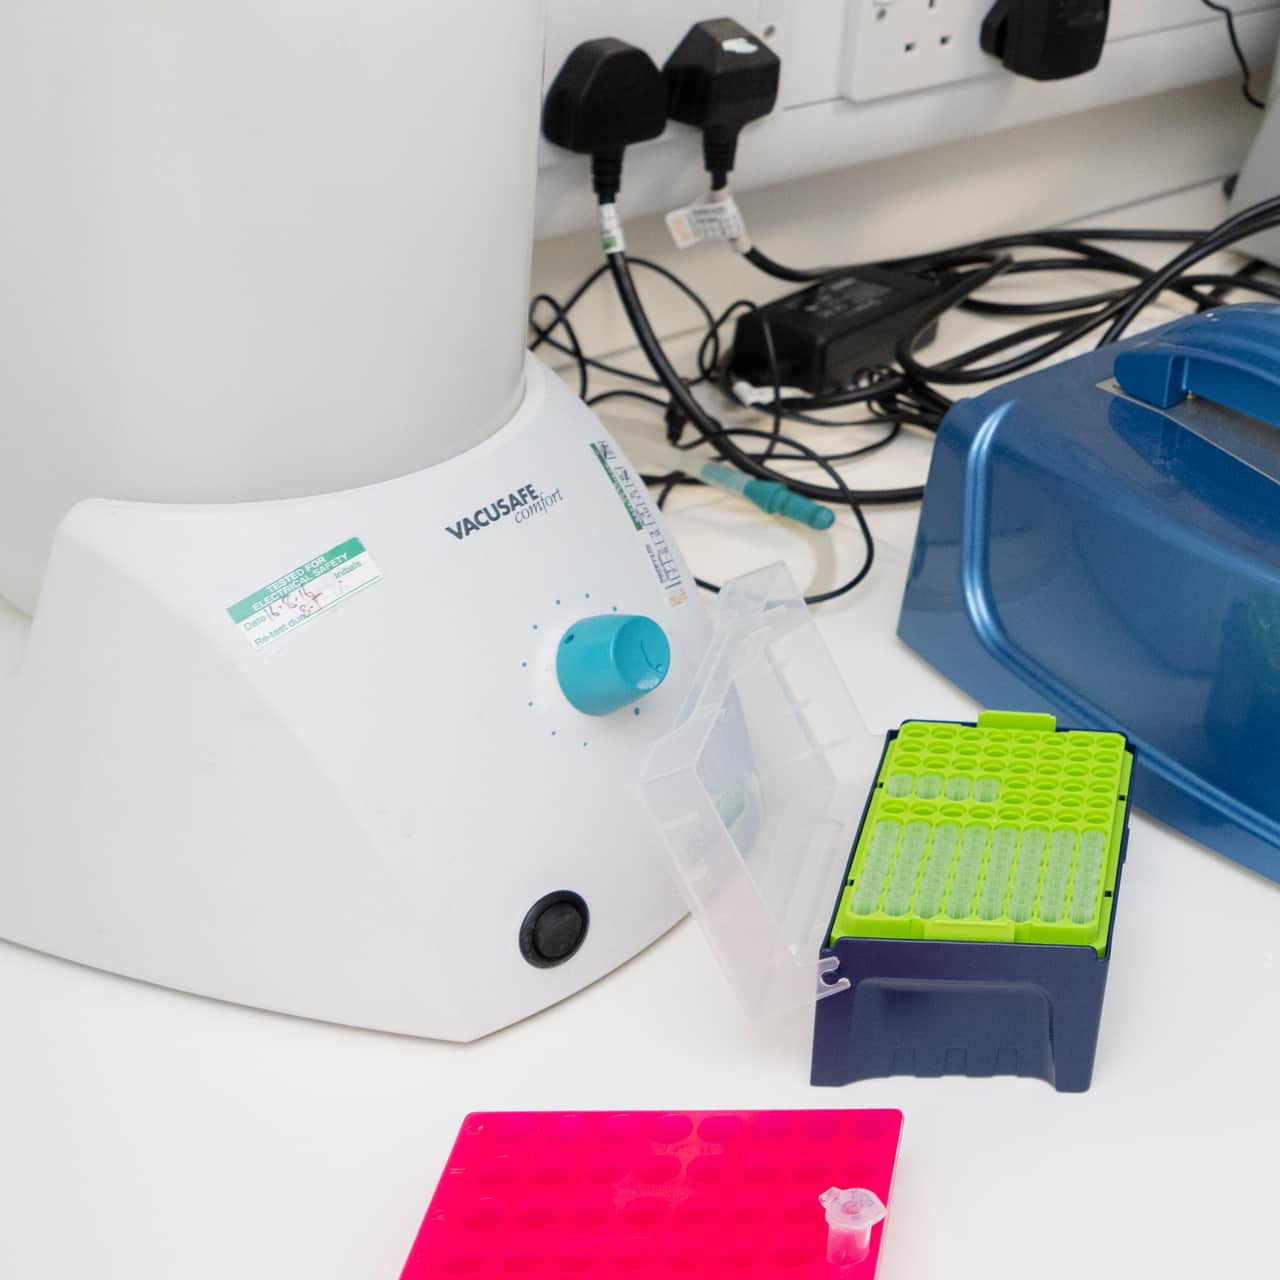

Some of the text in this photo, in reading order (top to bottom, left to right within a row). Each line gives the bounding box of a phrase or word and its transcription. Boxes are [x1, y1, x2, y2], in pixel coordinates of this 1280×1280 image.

[444, 483, 540, 540] VACUSAFE
[514, 487, 564, 524] comfort
[251, 551, 349, 612] ELECTRICAL SAFETY
[267, 555, 327, 593] TESTED FOR
[242, 614, 267, 632] Date
